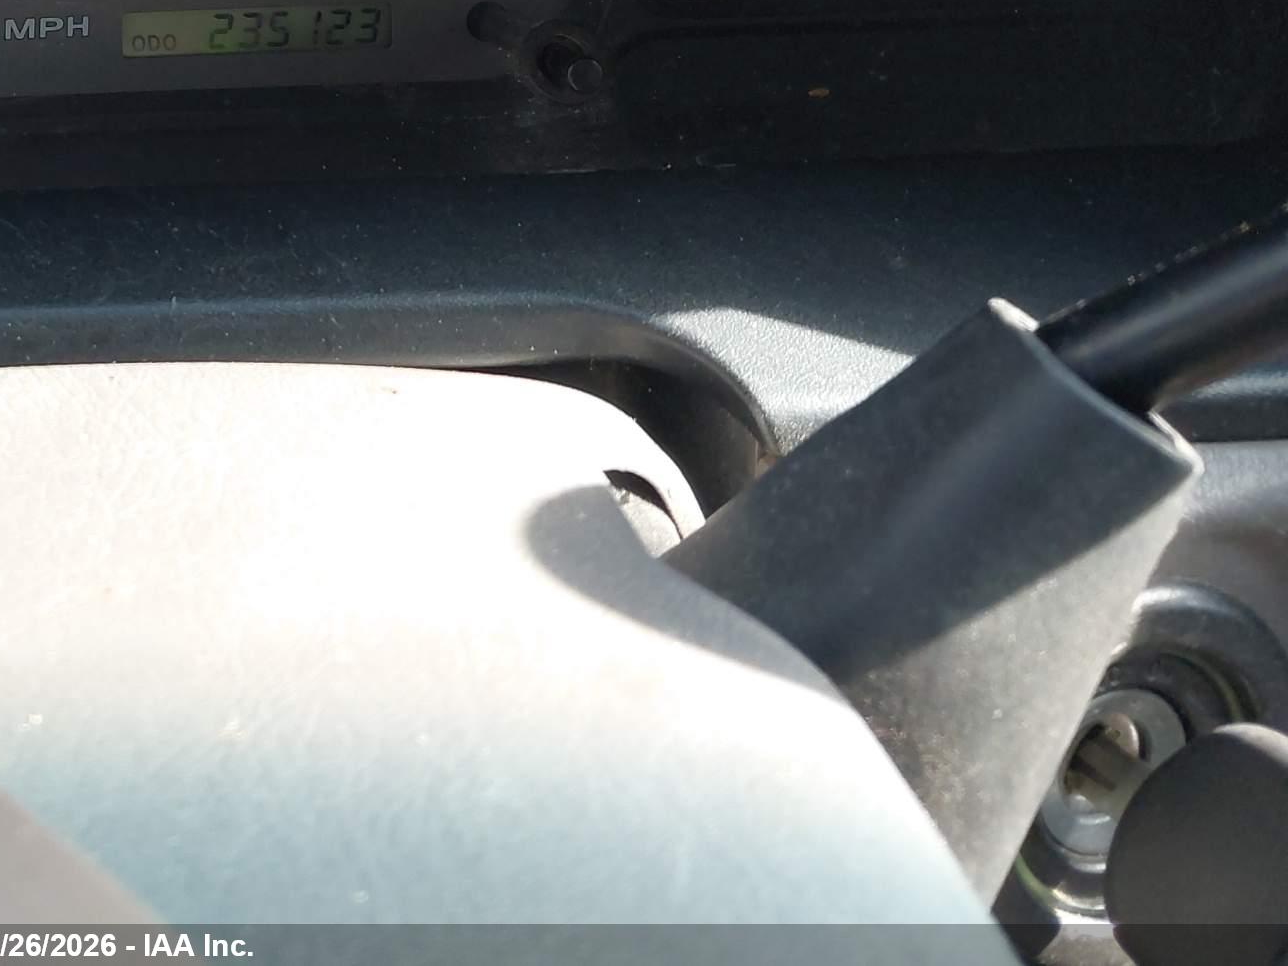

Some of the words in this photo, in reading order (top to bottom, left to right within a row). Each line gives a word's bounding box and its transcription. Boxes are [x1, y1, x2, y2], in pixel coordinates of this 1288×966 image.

[4, 15, 91, 40] MPH
[131, 34, 178, 52] ODO
[207, 7, 383, 51] 235123
